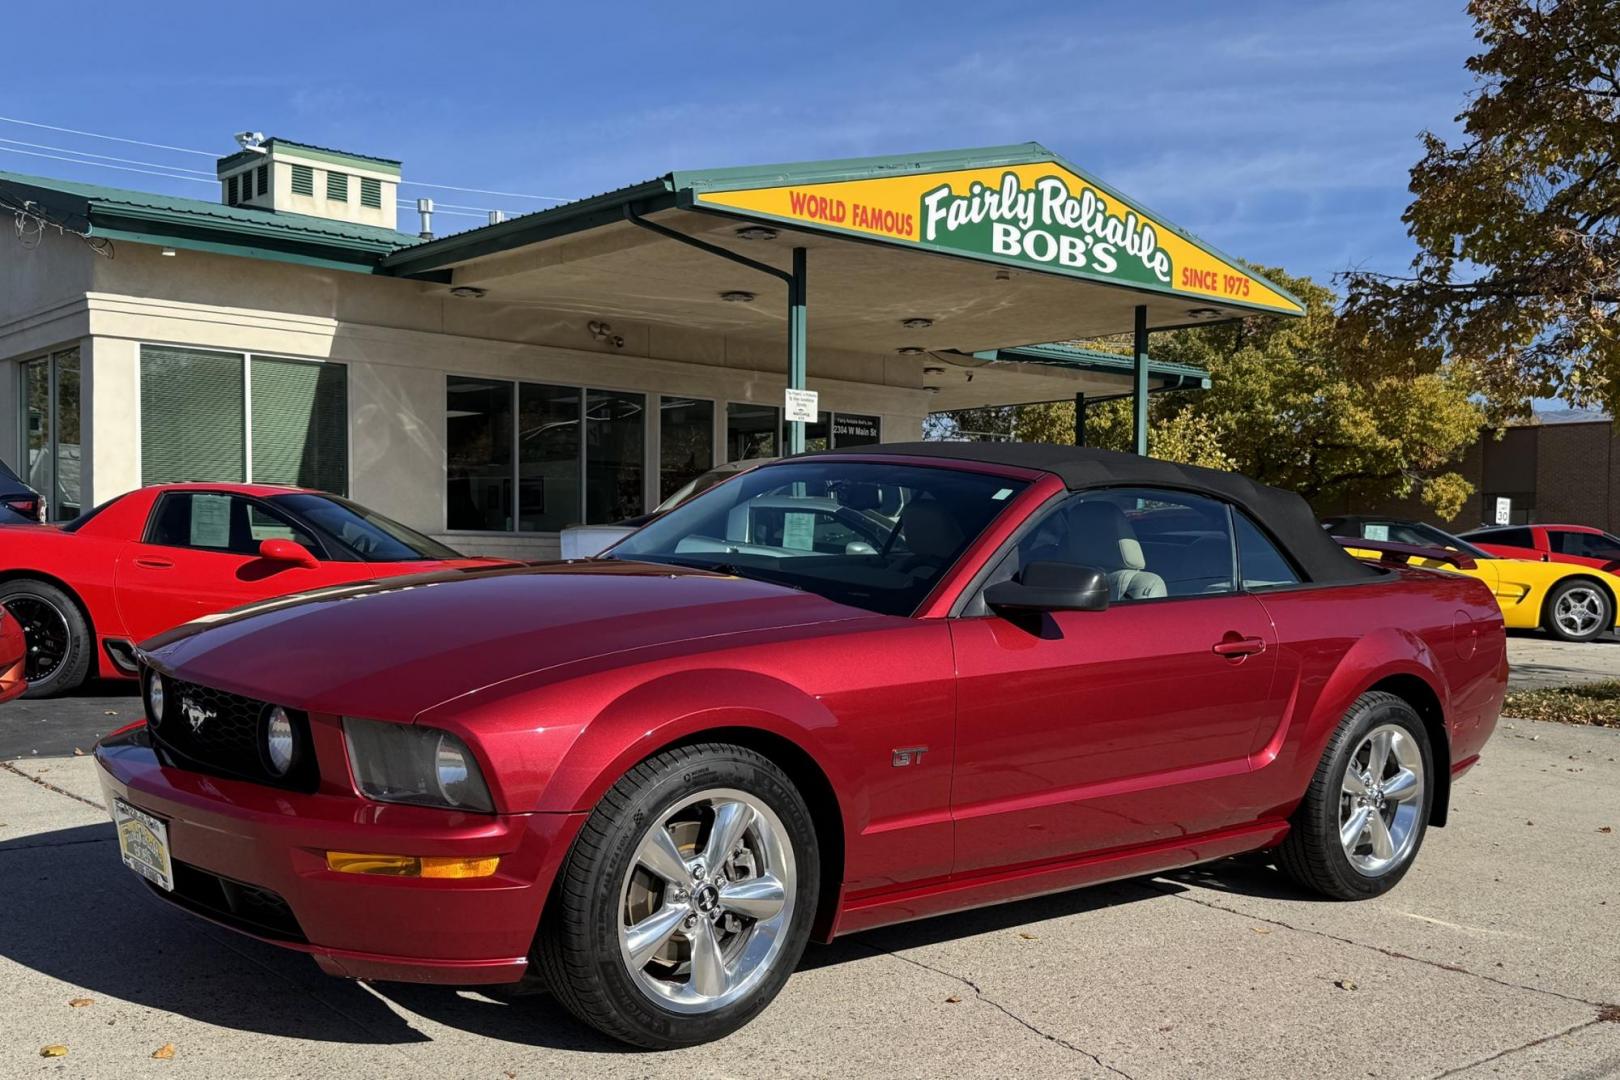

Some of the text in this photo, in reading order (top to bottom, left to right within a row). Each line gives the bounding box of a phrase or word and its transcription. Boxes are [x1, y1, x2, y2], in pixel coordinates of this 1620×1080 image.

[790, 190, 913, 236] WORLD FAMOUS
[925, 174, 1171, 282] Fairly Reliable
[992, 222, 1118, 274] BOB'S
[1182, 266, 1250, 297] SINCE 1975
[832, 425, 847, 434] 2304
[848, 426, 854, 435] W
[855, 426, 869, 436] Main
[1497, 511, 1508, 521] 30
[892, 747, 929, 767] GT
